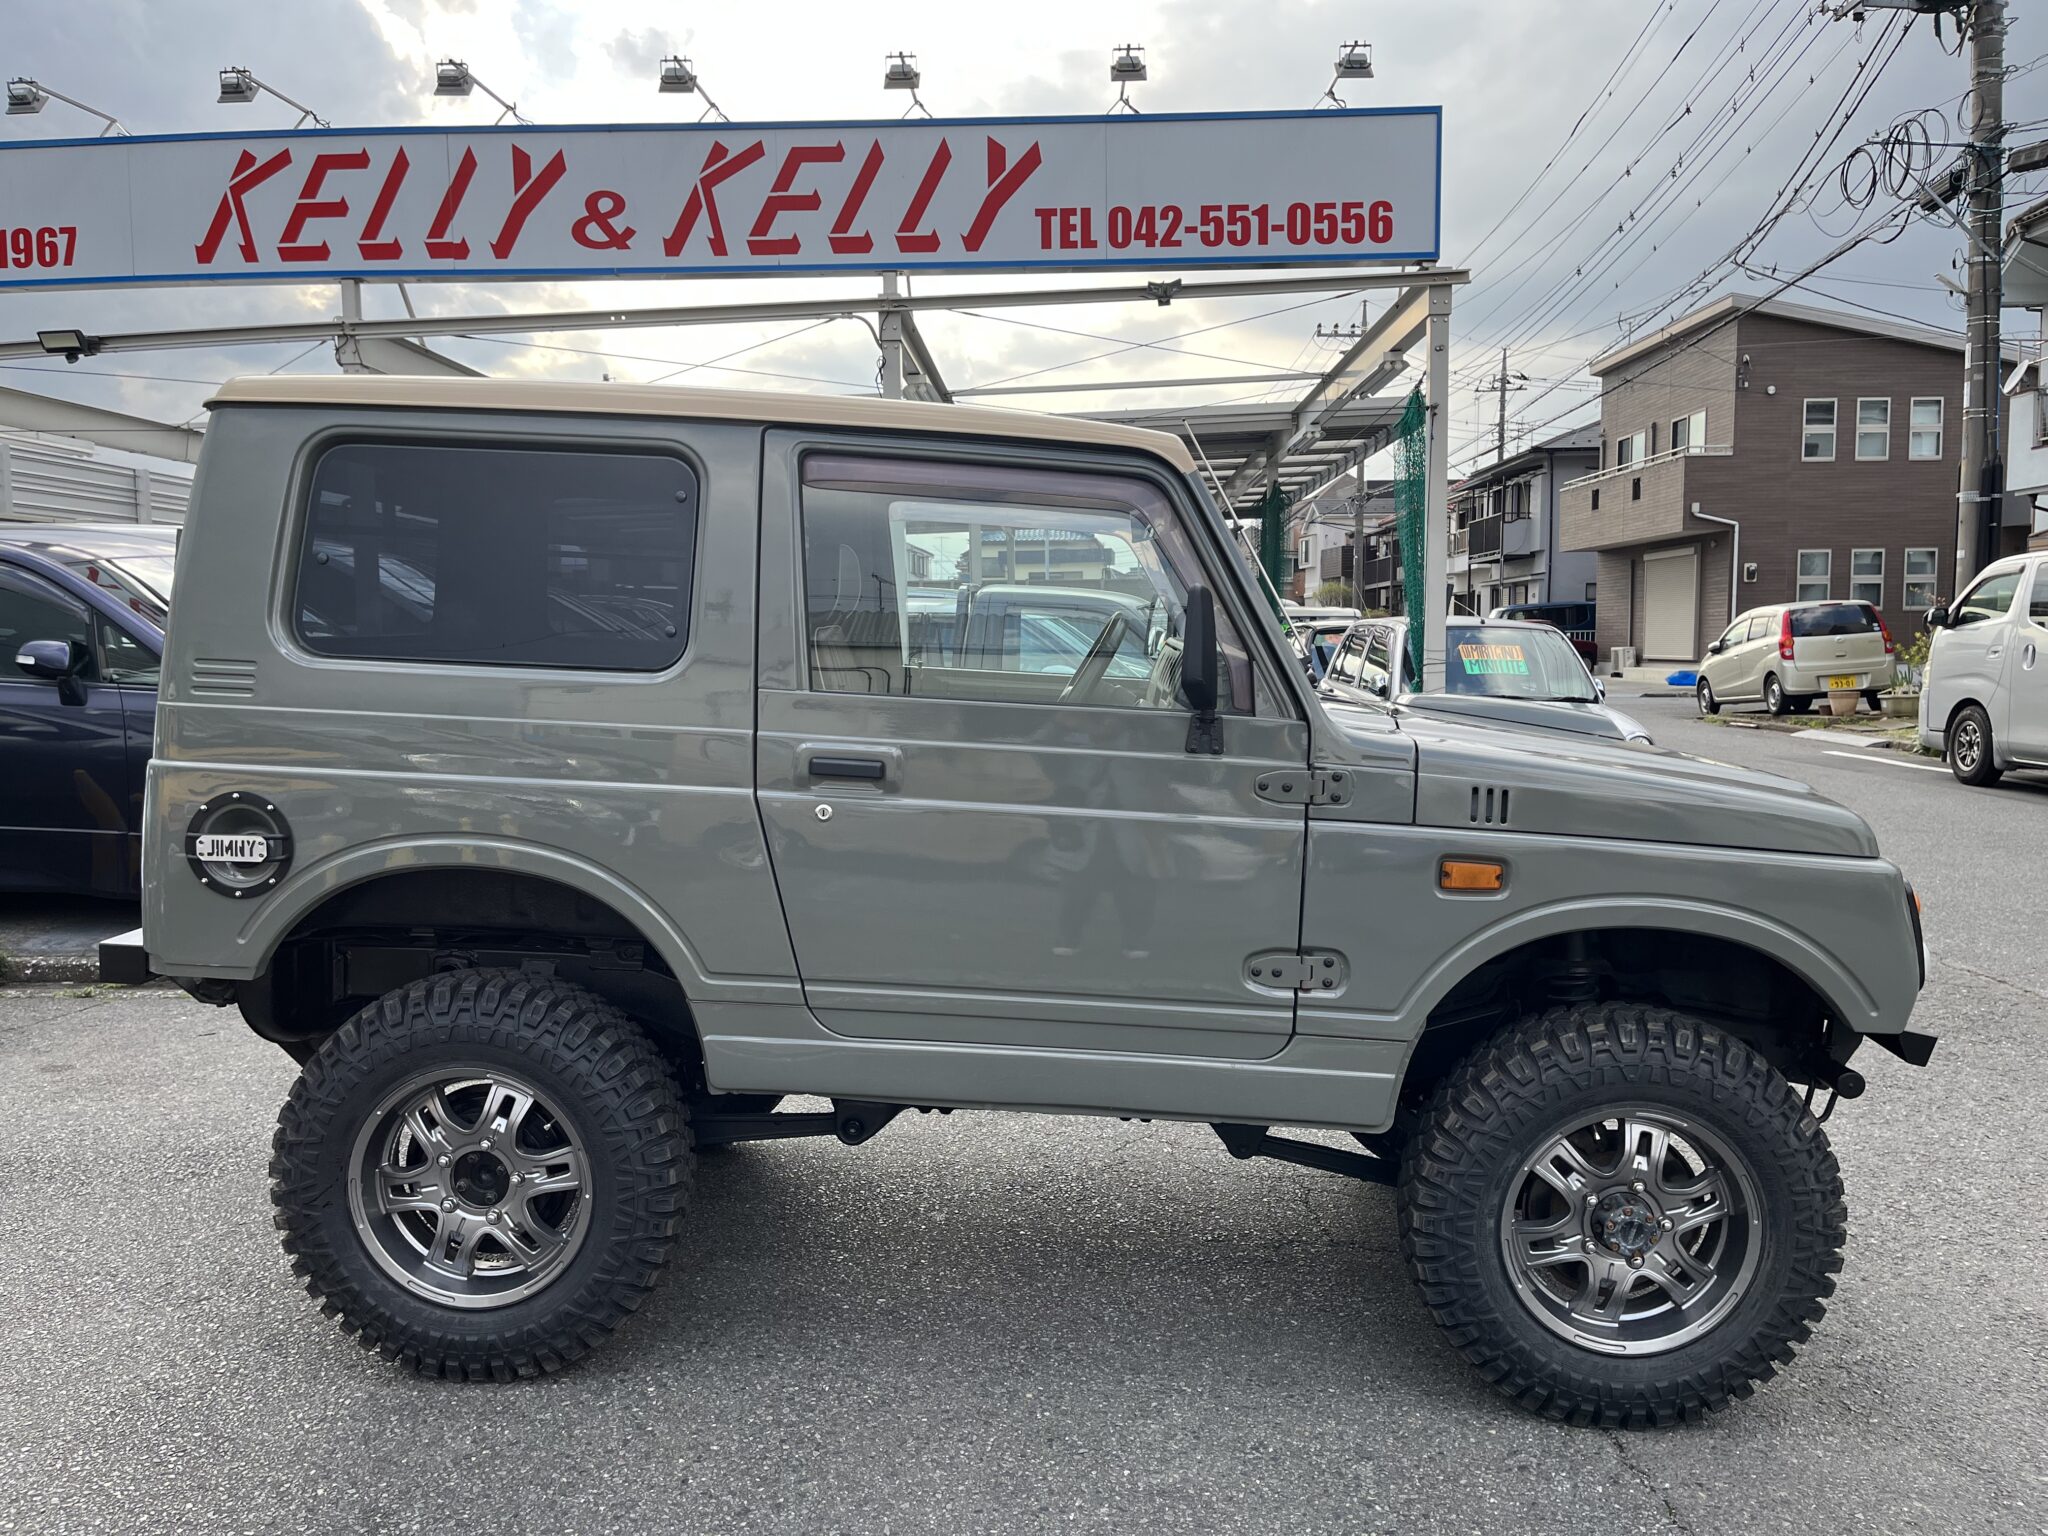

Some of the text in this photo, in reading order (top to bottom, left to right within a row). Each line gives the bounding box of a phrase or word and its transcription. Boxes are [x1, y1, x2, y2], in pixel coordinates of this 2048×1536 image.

[195, 135, 1041, 265] KELLY & KELLY
[1035, 201, 1394, 250] TEL 042-551-0556
[207, 839, 257, 857] JIMNY
